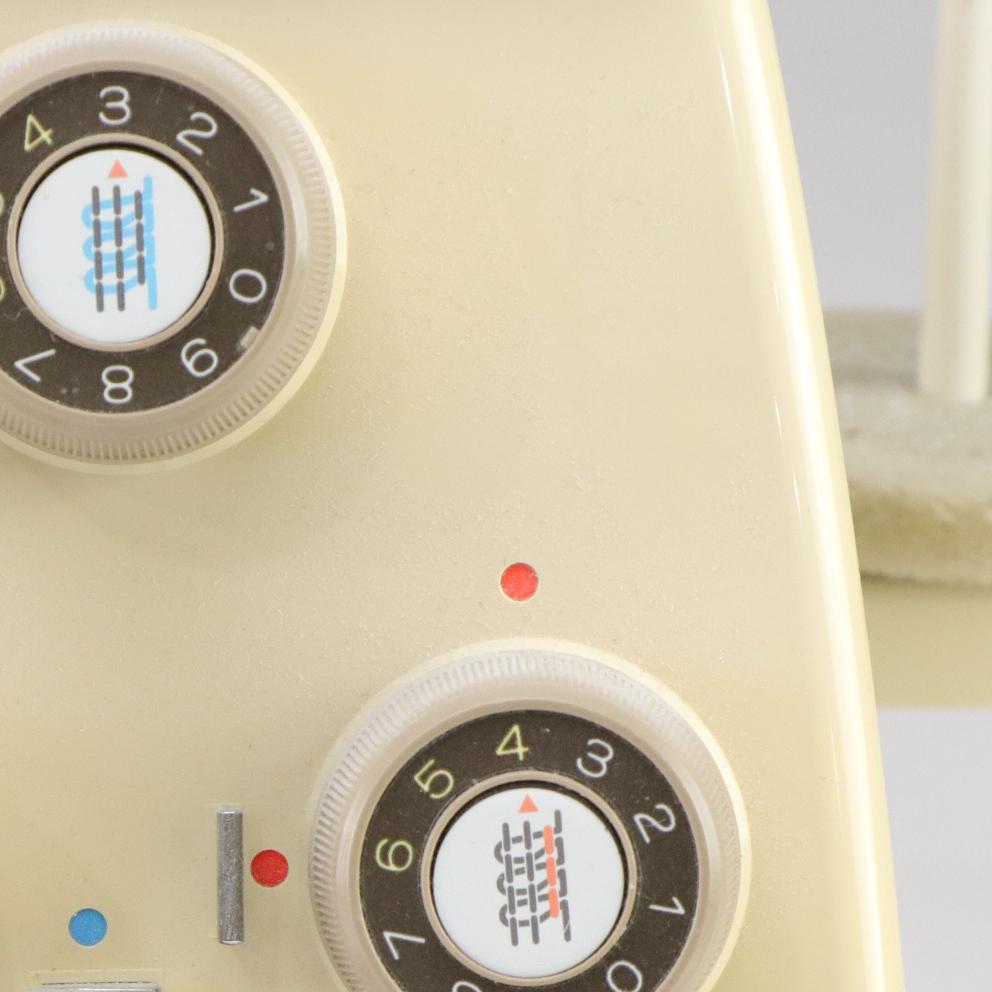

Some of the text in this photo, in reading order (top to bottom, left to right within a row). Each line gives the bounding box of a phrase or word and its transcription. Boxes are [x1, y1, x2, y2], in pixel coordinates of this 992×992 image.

[98, 85, 132, 127] 3
[22, 113, 55, 153] 4
[175, 110, 219, 157] 2
[233, 187, 270, 213] 1
[228, 268, 268, 305] 0
[12, 348, 58, 384] 7
[100, 364, 135, 405] 8
[494, 723, 530, 762] 4
[575, 738, 616, 779] 3
[412, 758, 456, 800] 5
[633, 803, 677, 845] 2
[374, 838, 414, 873] 6
[648, 896, 687, 916] 1
[381, 930, 426, 961] 7
